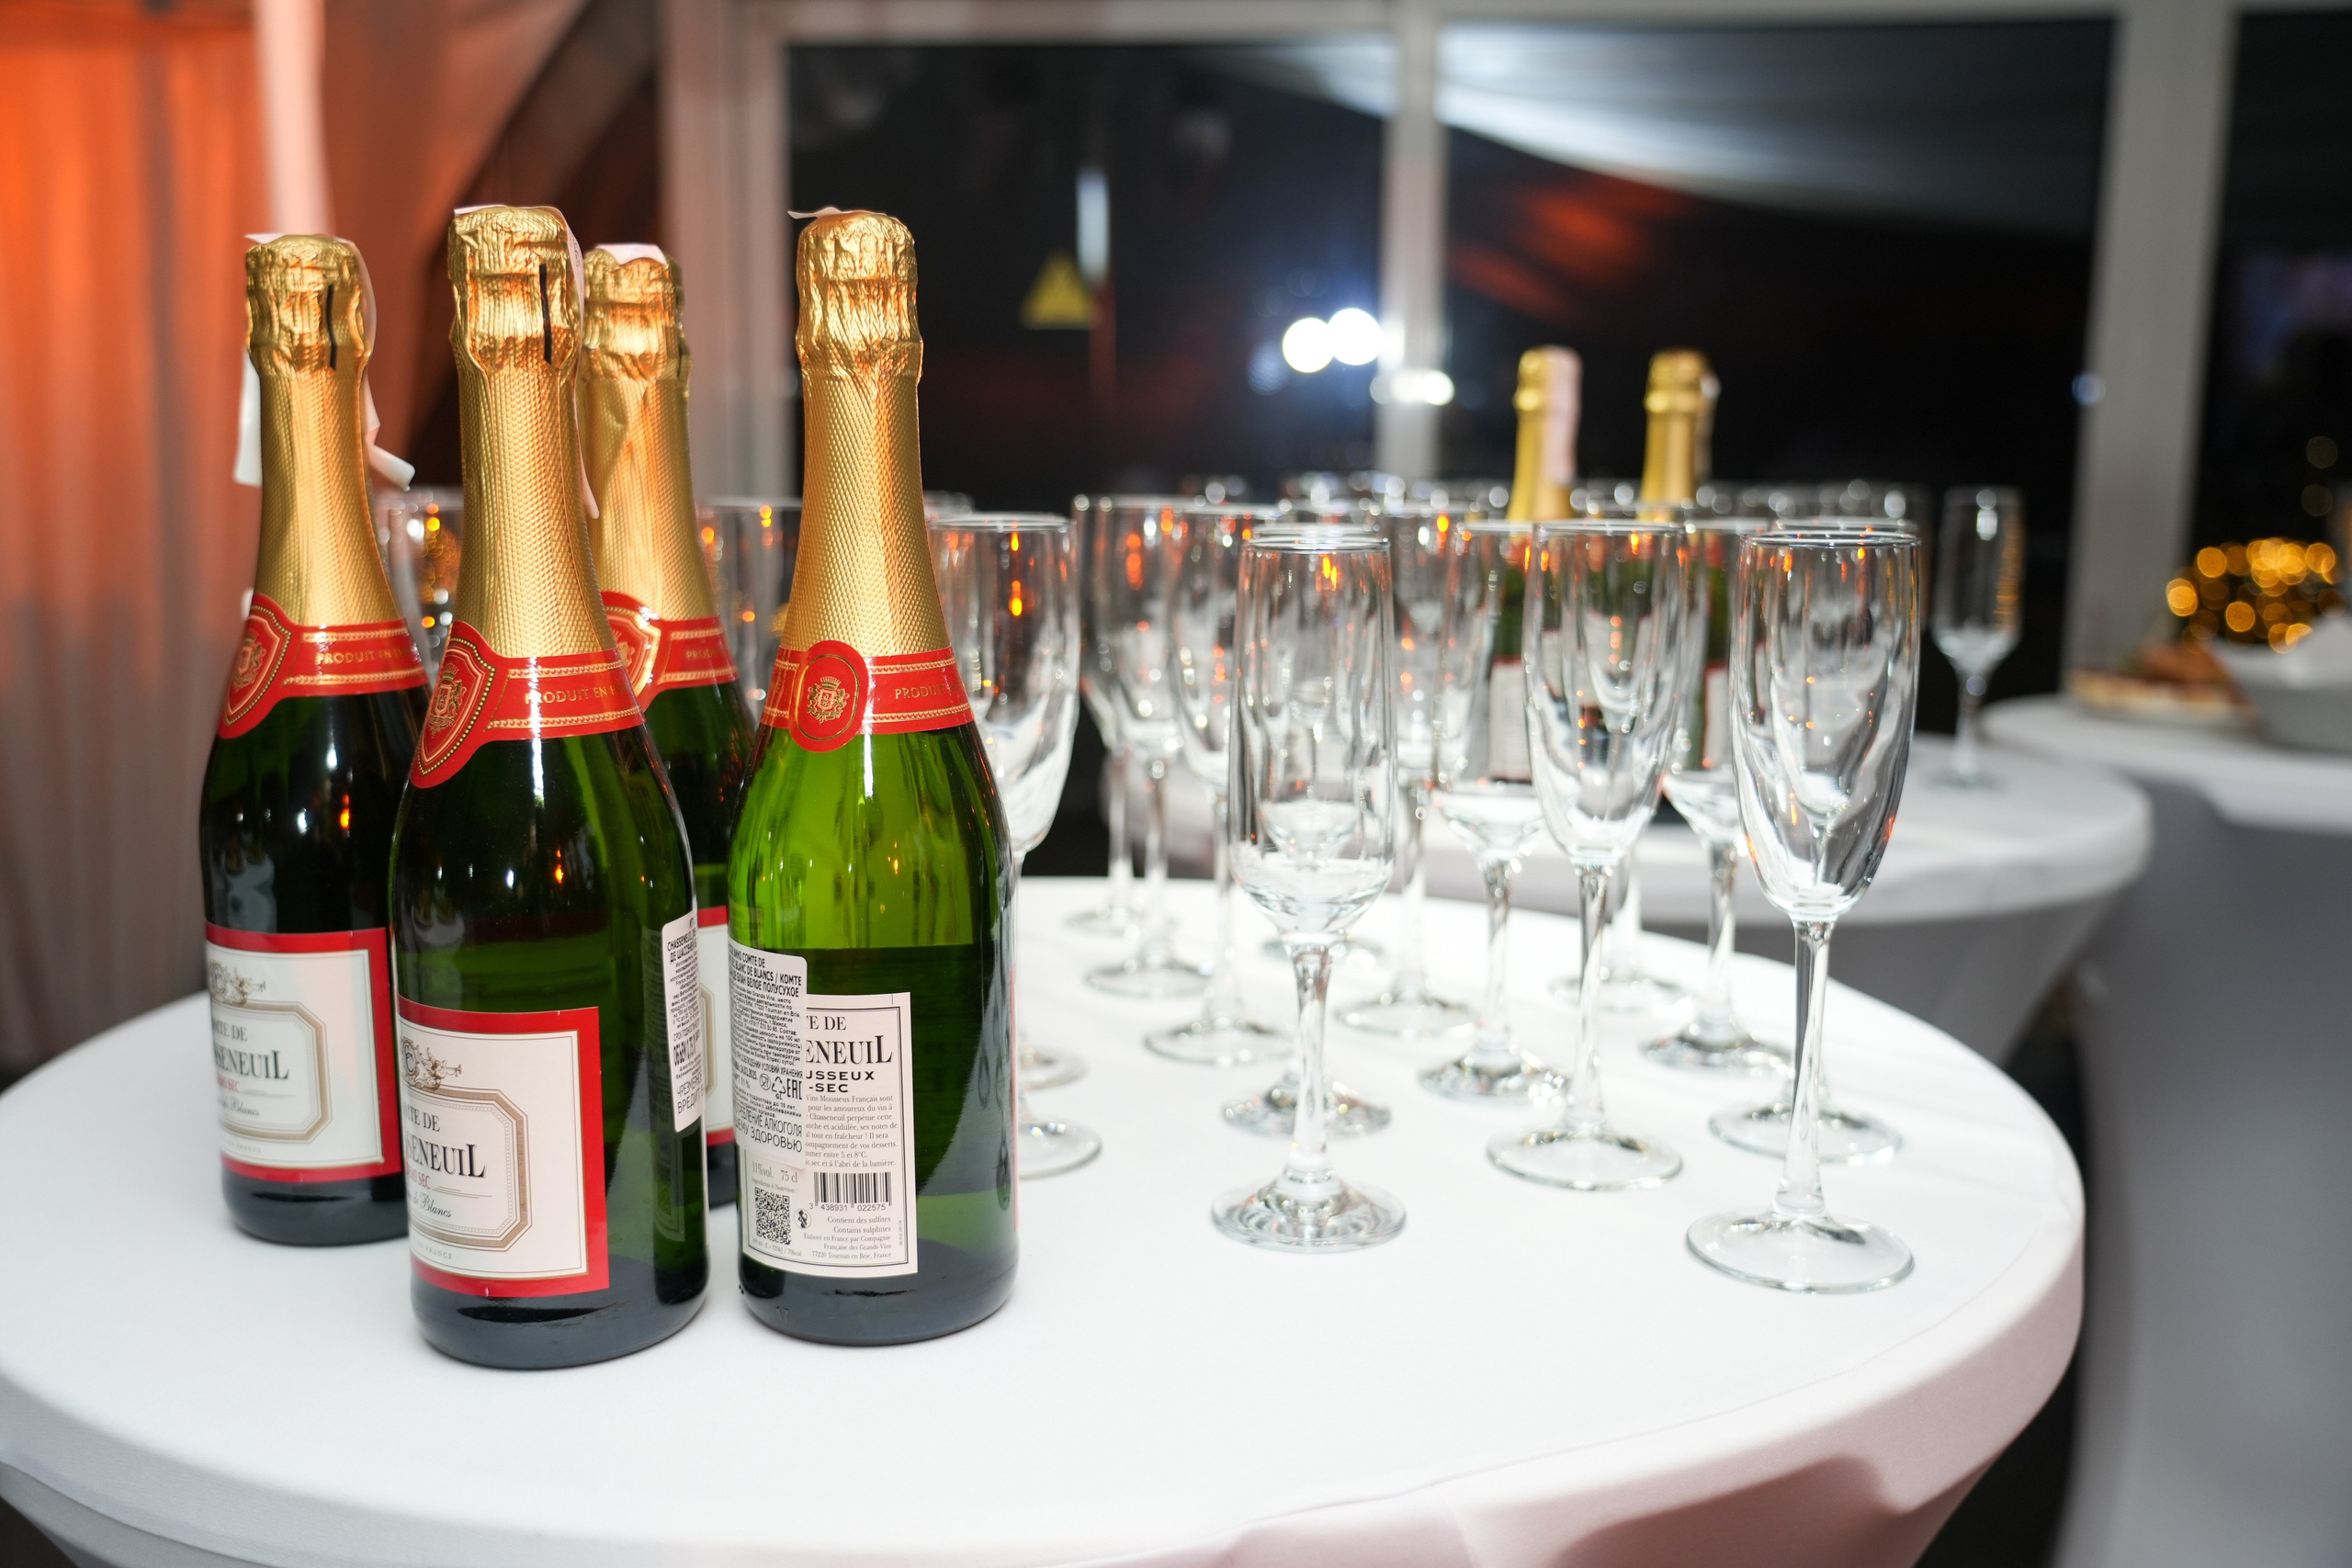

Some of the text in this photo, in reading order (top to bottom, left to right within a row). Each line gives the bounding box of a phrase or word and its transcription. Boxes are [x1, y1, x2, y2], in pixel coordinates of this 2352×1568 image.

[315, 650, 376, 665] PRODUIT
[525, 688, 589, 705] PRODUIT
[594, 686, 607, 698] EN
[895, 683, 944, 700] PRODUIT
[759, 957, 765, 968] DE
[754, 967, 774, 982] BLANCS
[763, 981, 799, 998] ПОЛУСУХОЕ
[824, 1016, 847, 1031] DE
[232, 1025, 248, 1042] DE
[779, 1027, 797, 1036] Состав:
[852, 1095, 878, 1103] Français
[424, 1112, 441, 1133] DE
[809, 1113, 845, 1121] Chasseneuil
[846, 1114, 876, 1123] perpétue
[764, 1117, 802, 1137] АЛКОГОЛЯ
[751, 1125, 802, 1153] ЗДОРОВЬЮ
[418, 1171, 431, 1190] SEC
[781, 1169, 790, 1182] 75
[791, 1171, 798, 1183] cl
[420, 1192, 452, 1219] Blancs
[820, 1203, 848, 1212] 438931
[857, 1203, 887, 1212] 022575
[827, 1215, 855, 1224] Contient
[869, 1215, 891, 1223] sulfites
[833, 1225, 891, 1235] Contains sulphites
[860, 1235, 891, 1243] Compagnie
[824, 1243, 848, 1251] Française
